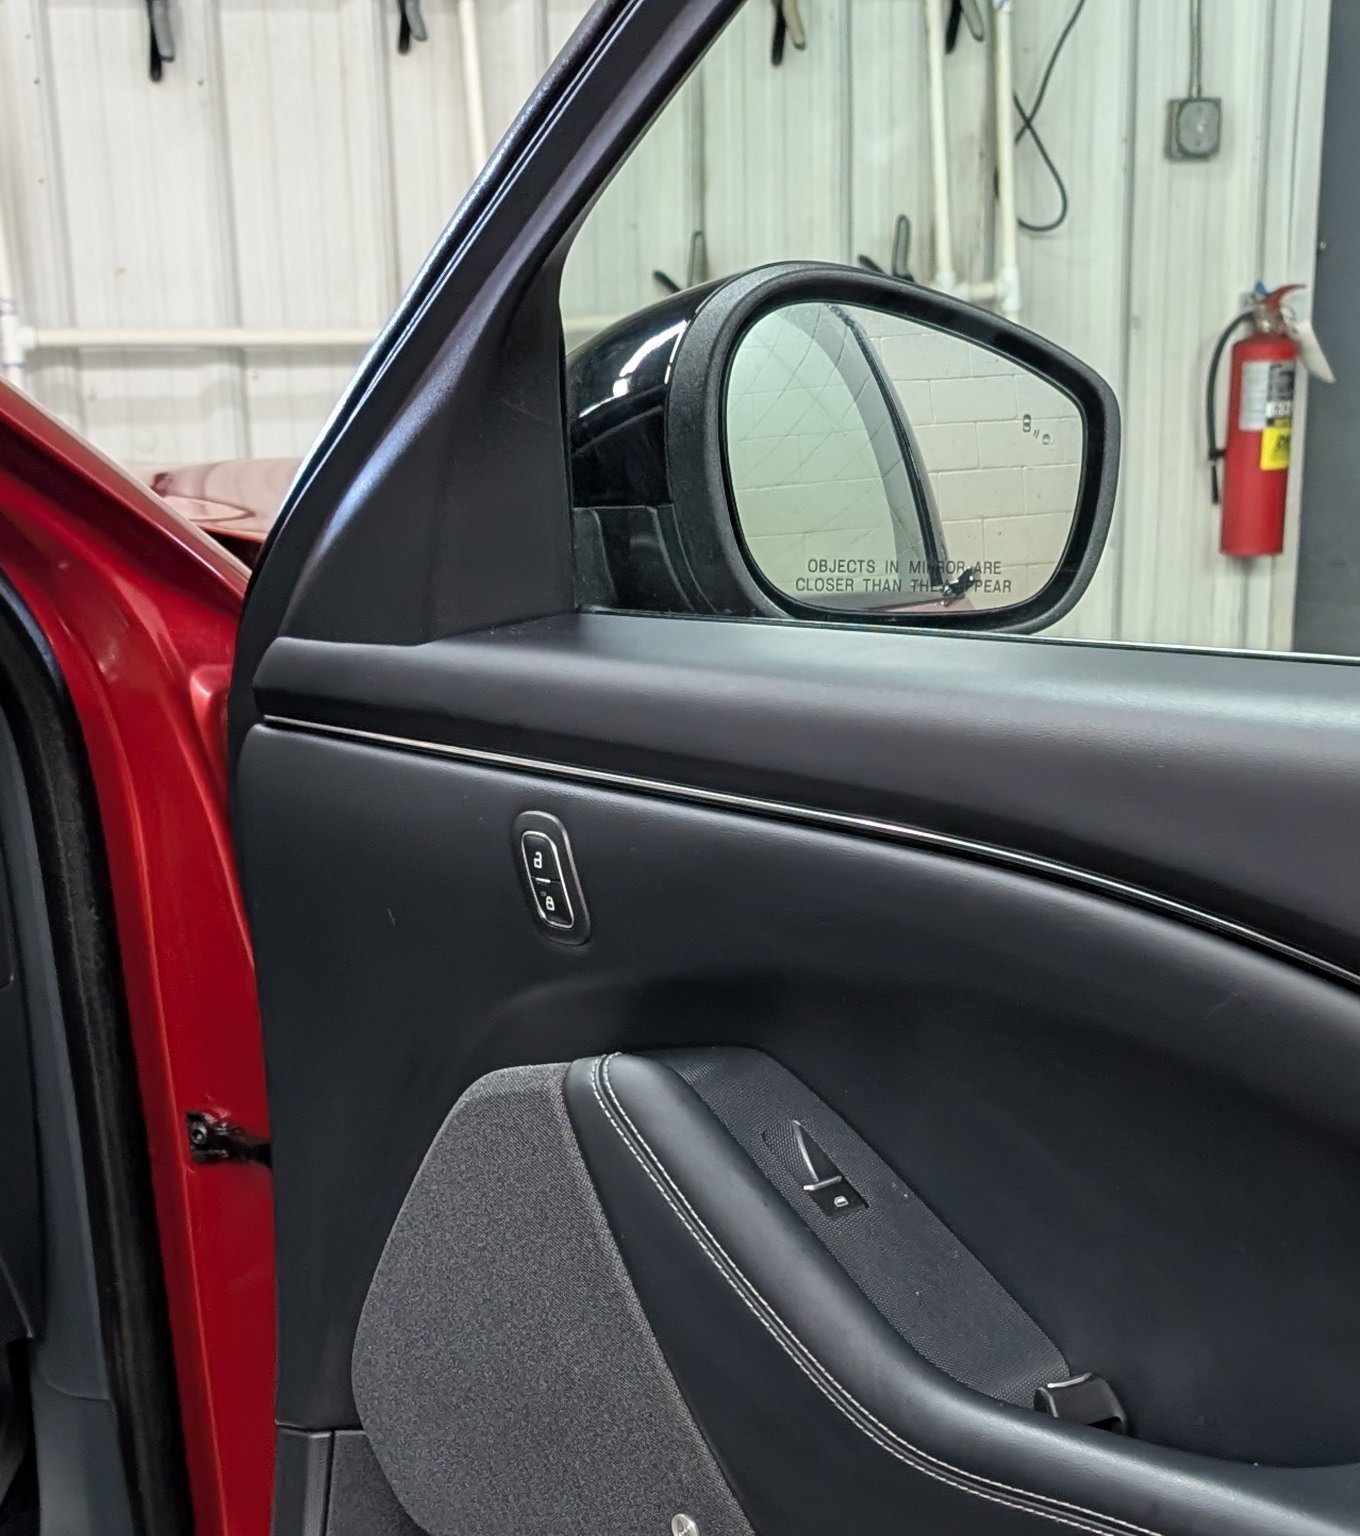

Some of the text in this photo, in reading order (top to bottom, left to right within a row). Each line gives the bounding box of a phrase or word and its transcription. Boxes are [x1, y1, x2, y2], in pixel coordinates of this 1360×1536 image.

[807, 558, 876, 574] OBJECTS
[885, 559, 899, 575] IN
[974, 561, 1002, 575] ARE
[795, 578, 855, 592] CLOSER
[863, 579, 902, 592] THAN
